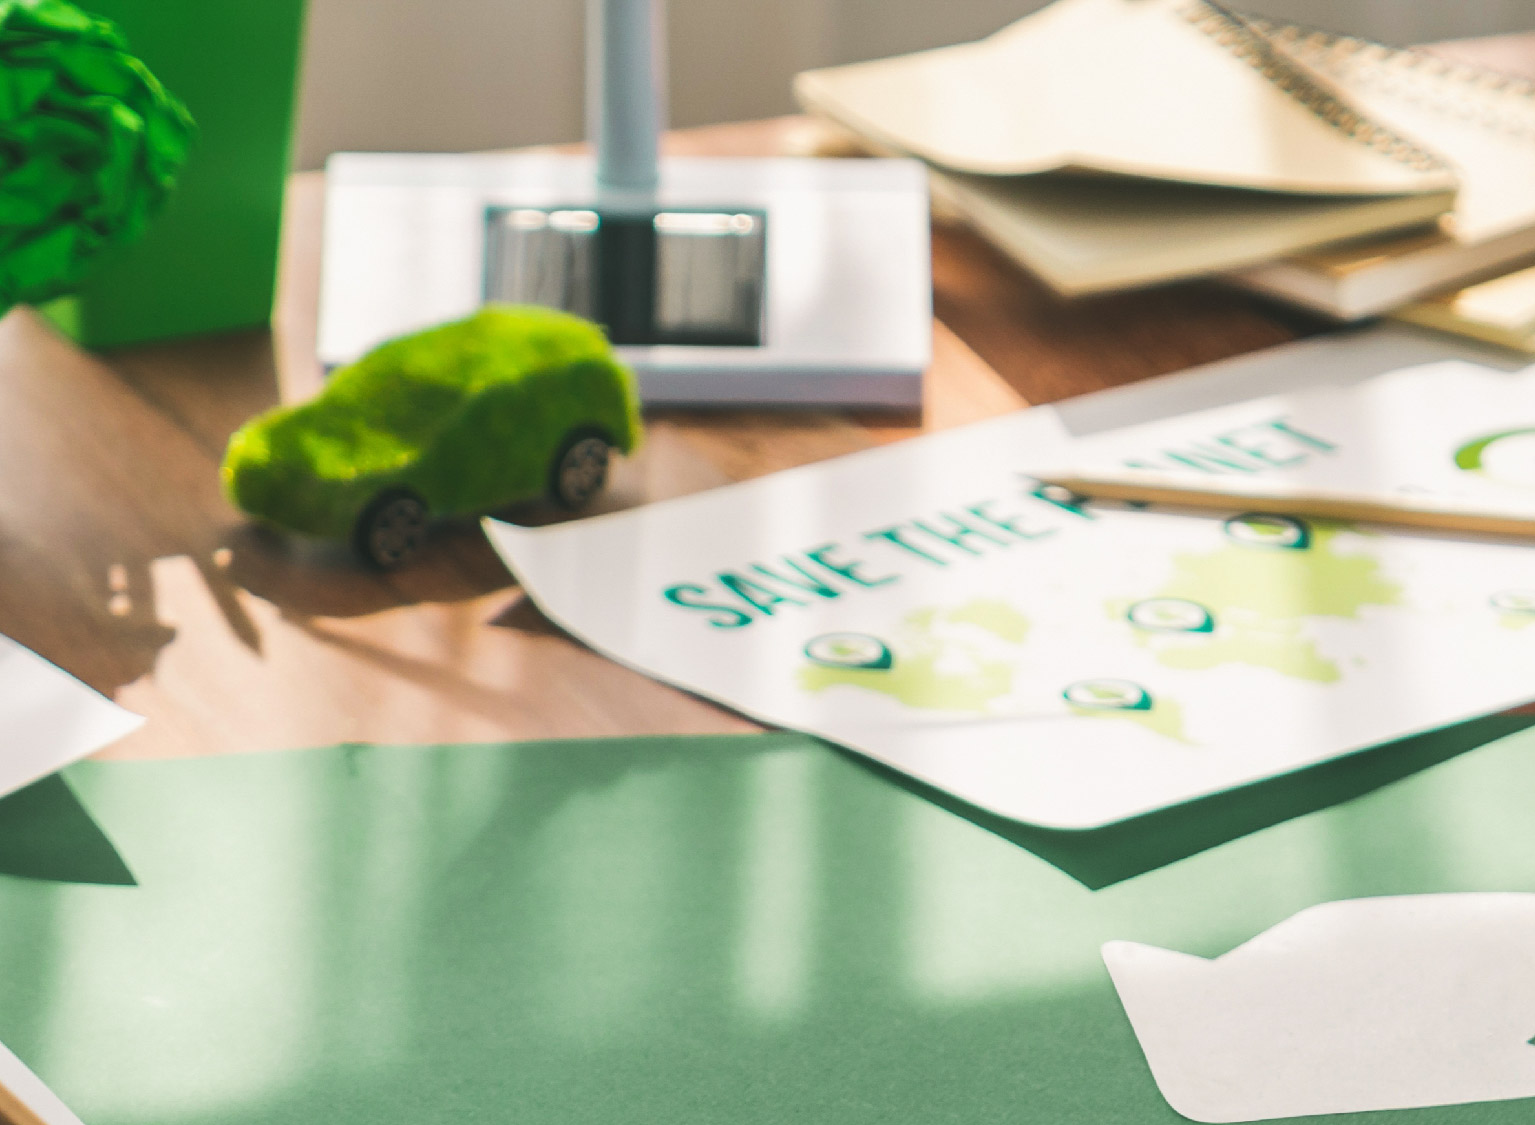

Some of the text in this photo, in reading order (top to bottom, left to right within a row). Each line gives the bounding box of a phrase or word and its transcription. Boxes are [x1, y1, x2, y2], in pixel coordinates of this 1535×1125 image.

[664, 416, 1337, 631] SAVE THE PNET
